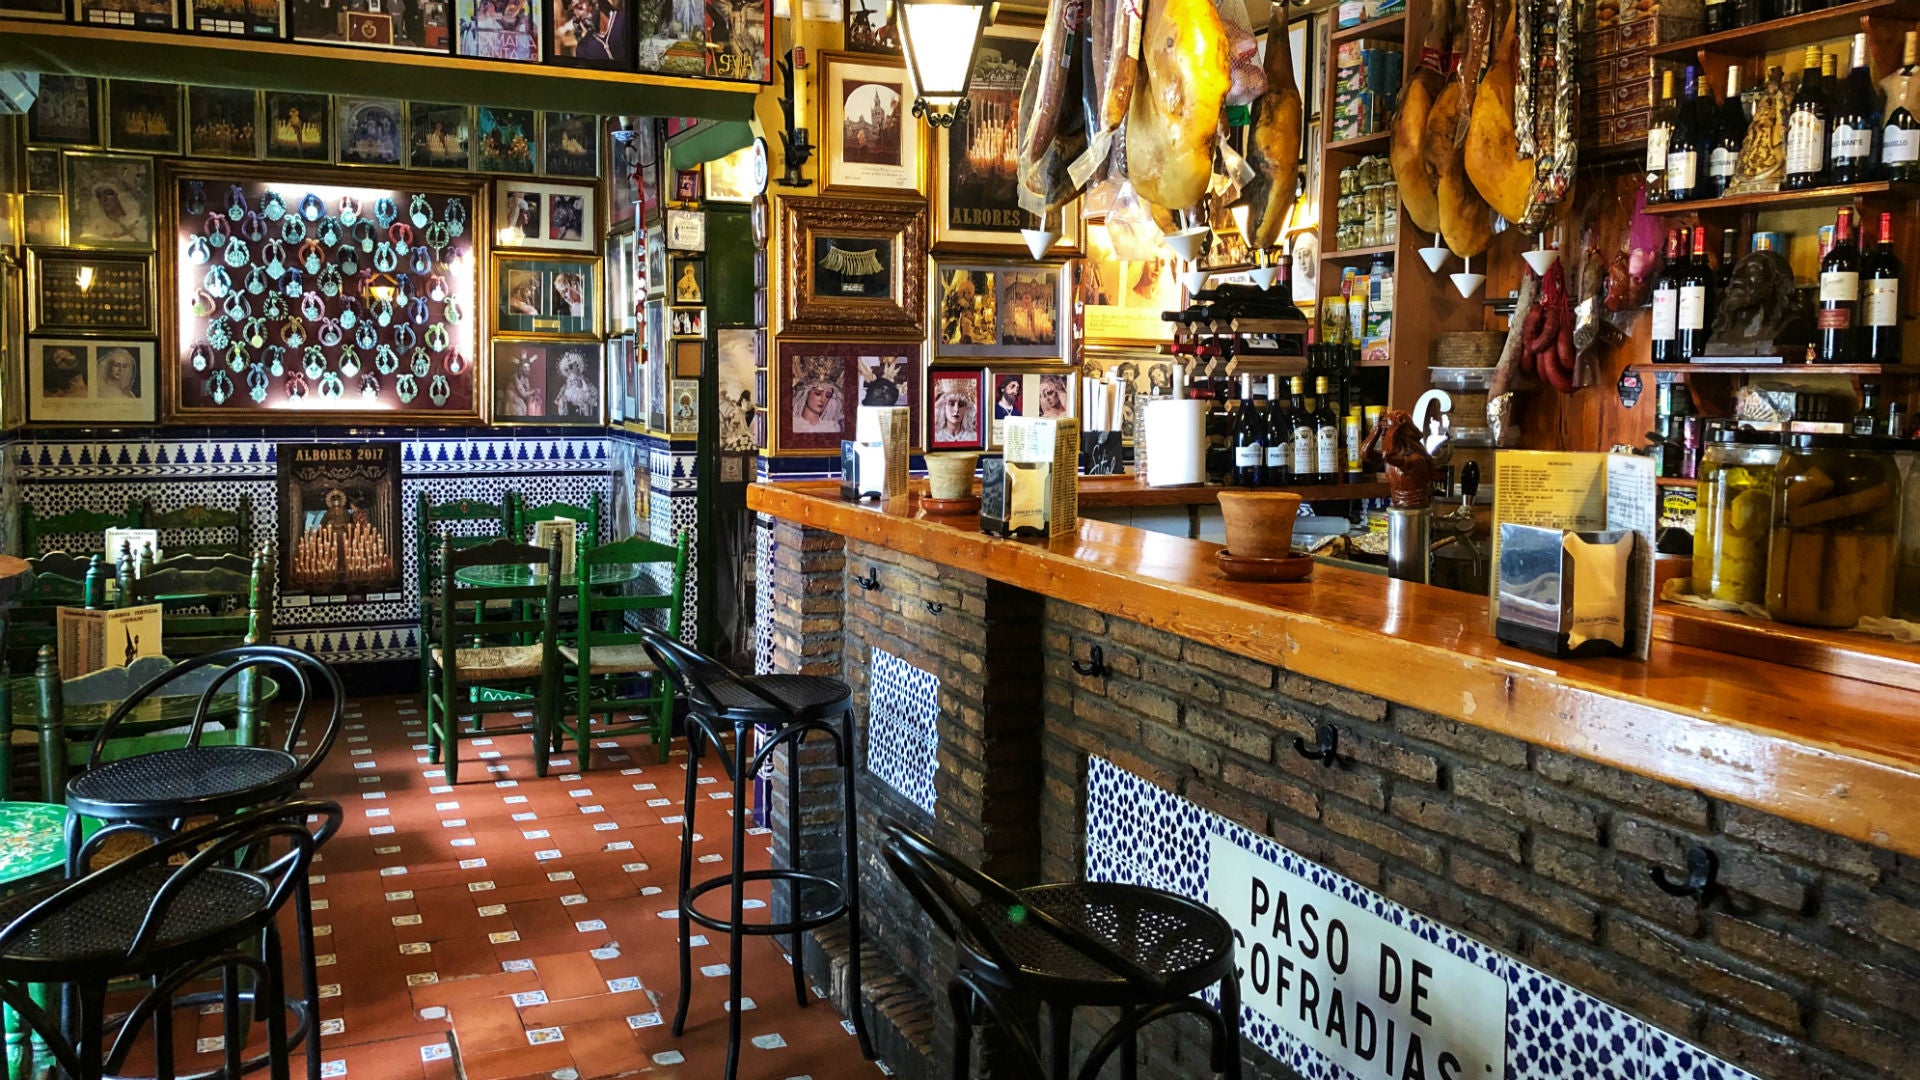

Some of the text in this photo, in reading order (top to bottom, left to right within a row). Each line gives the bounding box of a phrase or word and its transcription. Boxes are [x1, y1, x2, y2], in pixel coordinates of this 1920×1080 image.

[951, 207, 1021, 226] ALBORES
[295, 448, 384, 461] ALBORES 2017
[1251, 876, 1433, 1026] PASO DE
